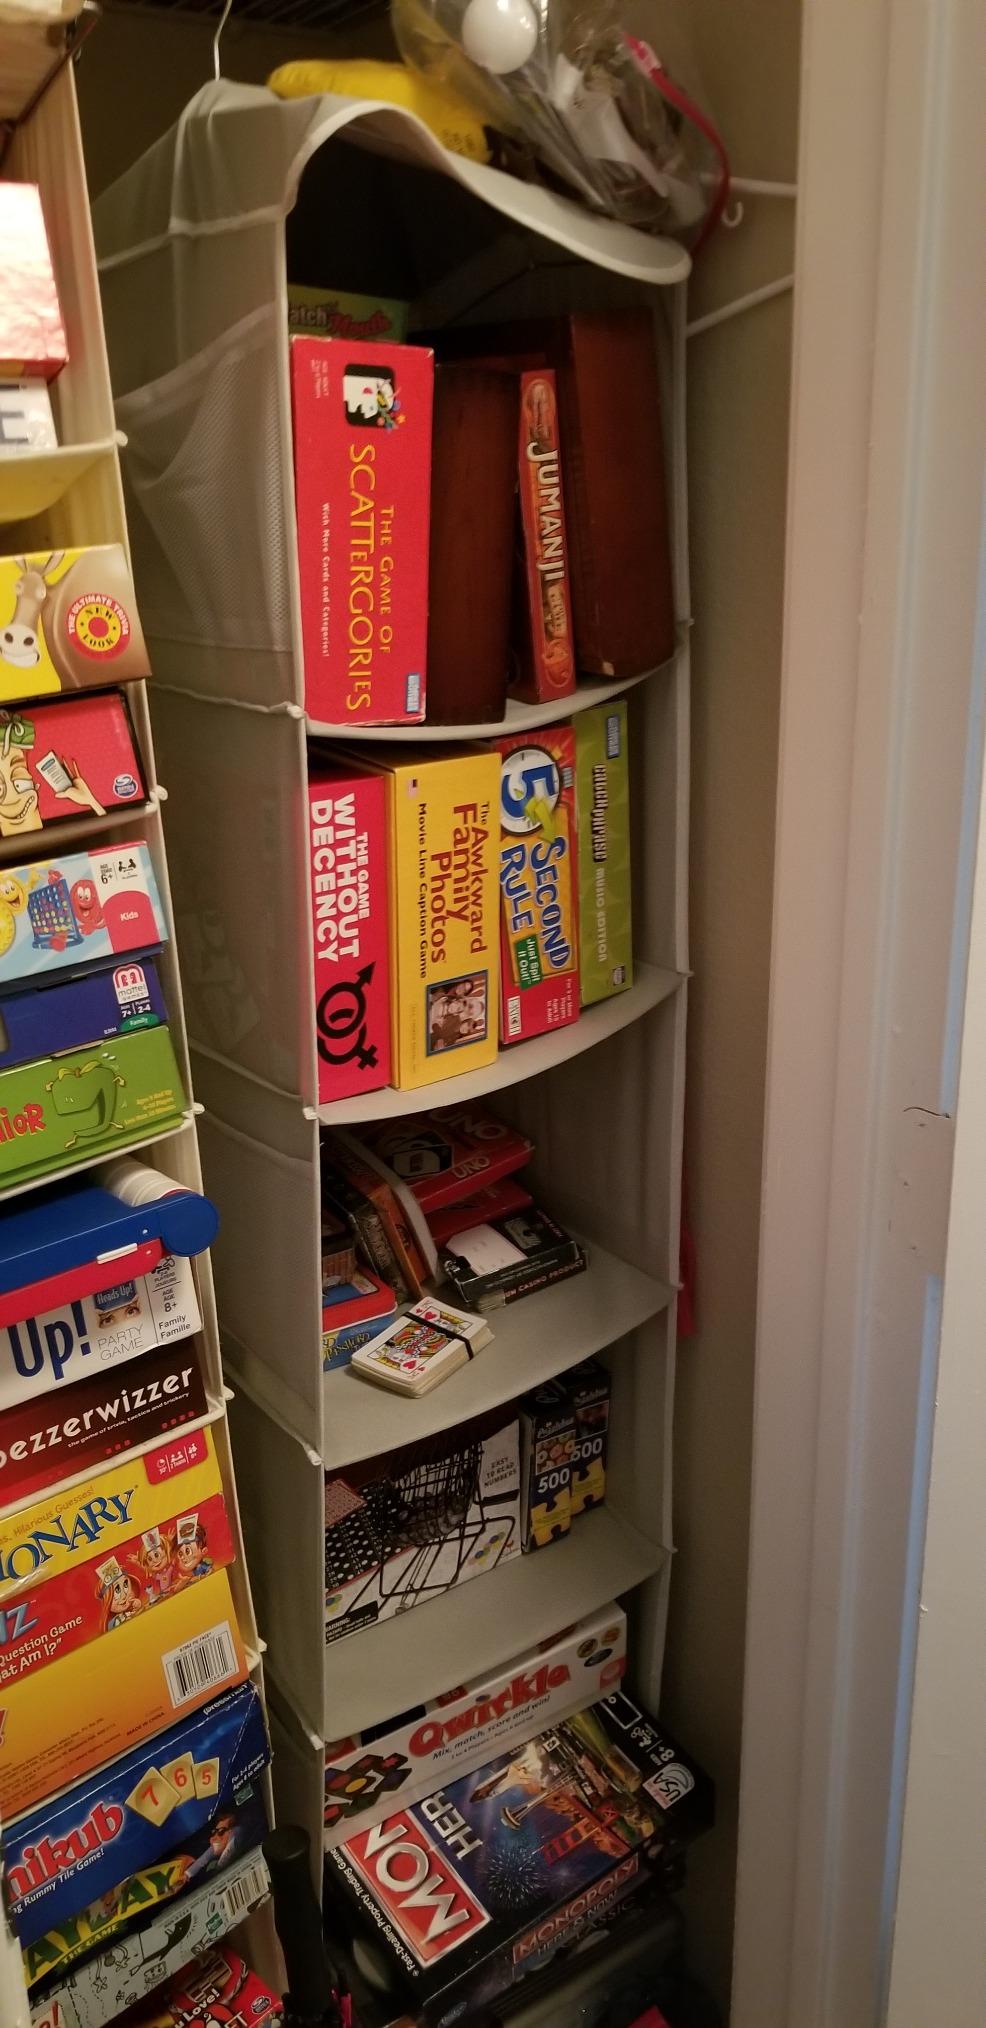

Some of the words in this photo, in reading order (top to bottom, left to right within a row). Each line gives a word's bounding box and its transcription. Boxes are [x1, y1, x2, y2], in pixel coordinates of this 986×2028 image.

[322, 503, 330, 525] With
[380, 506, 394, 545] THE
[527, 442, 564, 581] JUMANJI
[322, 530, 330, 552] More
[322, 557, 330, 582] Cards
[346, 444, 375, 711] SCATTERGORIES
[322, 586, 330, 602] and
[380, 556, 394, 614] GAME
[86, 606, 112, 620] NEW
[83, 634, 114, 648] LOOK
[321, 607, 330, 657] Categories!
[379, 625, 393, 653] OF
[501, 764, 557, 818] 5
[418, 803, 427, 845] Movie
[479, 801, 490, 825] The
[356, 832, 368, 865] THE
[447, 803, 477, 921] Family
[334, 793, 359, 958] WITHOUT
[418, 850, 427, 879] Line
[311, 799, 338, 962] DECENCY
[357, 870, 369, 918] GAME
[469, 827, 489, 954] Awkward
[500, 841, 535, 932] RULE
[120, 912, 139, 921] Kids
[418, 883, 428, 935] Caption
[430, 851, 452, 964] Photos
[531, 837, 572, 968] SECOND
[419, 940, 428, 978] Game
[518, 950, 527, 958] It
[526, 938, 538, 960] Just
[519, 960, 529, 981] Out!
[528, 962, 539, 982] Spit
[120, 984, 146, 997] mattel
[121, 1009, 132, 1018] 7+
[137, 1004, 151, 1014] 2-4
[130, 1017, 148, 1026] Family
[451, 1155, 491, 1179] UNO
[97, 1287, 119, 1304] Heads
[119, 1284, 133, 1300] Up!
[164, 1302, 177, 1313] 8+
[98, 1324, 144, 1348] PARTY
[158, 1315, 187, 1330] Family
[160, 1323, 191, 1340] Famille
[7, 1300, 92, 1381] Up!
[100, 1338, 143, 1361] GAME
[68, 1439, 81, 1448] the
[81, 1432, 99, 1444] game
[99, 1427, 107, 1435] of
[127, 1410, 151, 1422] tactics
[151, 1403, 163, 1412] and
[163, 1392, 190, 1406] trickery
[572, 1438, 602, 1462] 500
[484, 1469, 517, 1488] NUMBERS
[538, 1468, 570, 1493] 500
[56, 1485, 95, 1513] Guesses!
[50, 1615, 83, 1638] Game
[0, 1664, 18, 1682] at
[20, 1651, 42, 1673] Am
[408, 1663, 571, 1758] Qwirkle
[127, 1725, 142, 1737] MADE
[454, 1731, 486, 1750] match,
[488, 1716, 511, 1732] score
[513, 1705, 531, 1720] and
[140, 1785, 160, 1807] 7
[173, 1767, 188, 1787] 6
[202, 1769, 212, 1785] 5
[653, 1772, 681, 1802] USA
[330, 1848, 346, 1870] Game
[24, 1882, 57, 1906] Rummy
[58, 1868, 75, 1883] Tile
[77, 1848, 105, 1871] Game!
[343, 1868, 364, 1896] Trading
[361, 1894, 386, 1928] Property
[519, 1860, 635, 1956] MONOPOLY
[86, 1924, 119, 1946] GAME
[382, 1924, 416, 1971] Fast-Dealing
[183, 1988, 220, 2021] Love!
